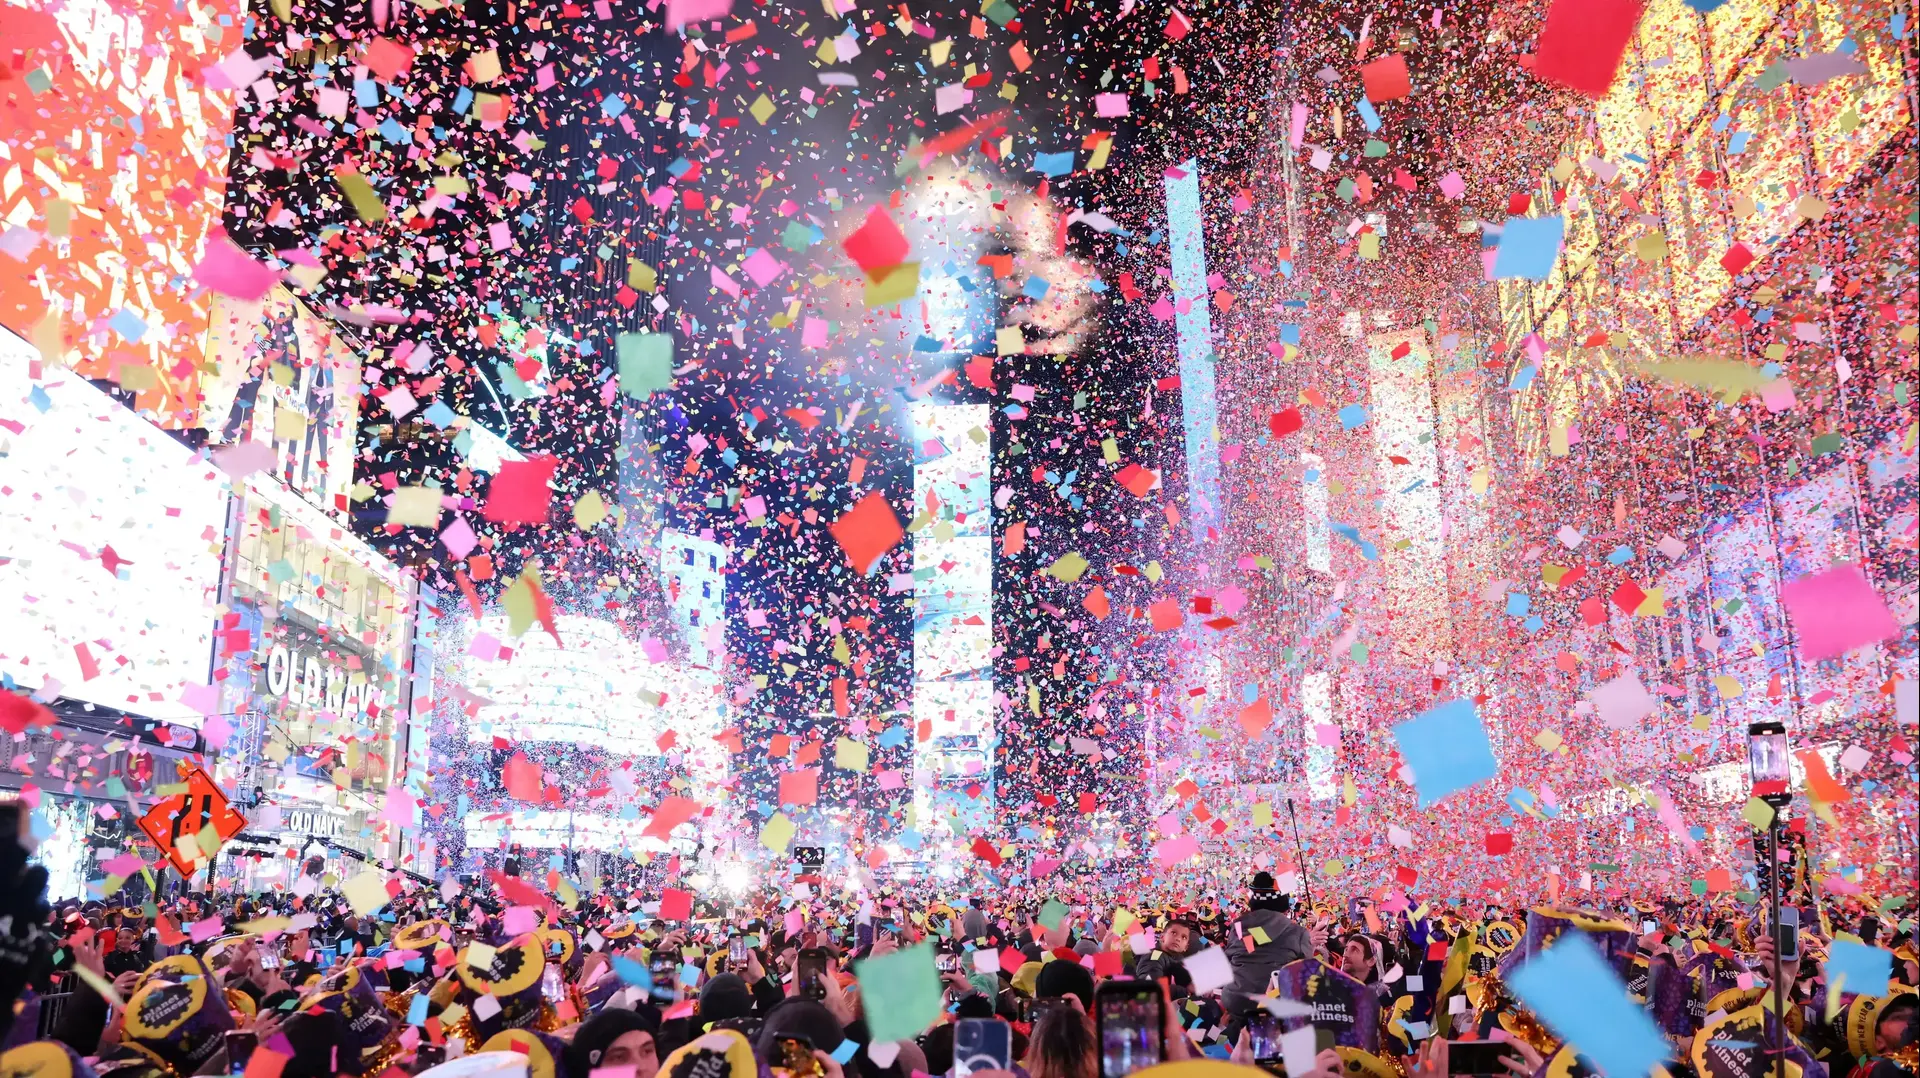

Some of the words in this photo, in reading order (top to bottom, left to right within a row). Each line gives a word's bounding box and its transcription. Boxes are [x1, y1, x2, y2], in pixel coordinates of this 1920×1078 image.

[266, 644, 321, 706] OLD
[290, 811, 312, 832] OLD
[313, 814, 343, 837] NAVY
[144, 995, 180, 1021] planet
[151, 996, 191, 1023] fitness
[350, 1006, 375, 1031] planet
[1311, 1010, 1355, 1023] fitness
[1312, 1001, 1346, 1012] lanet
